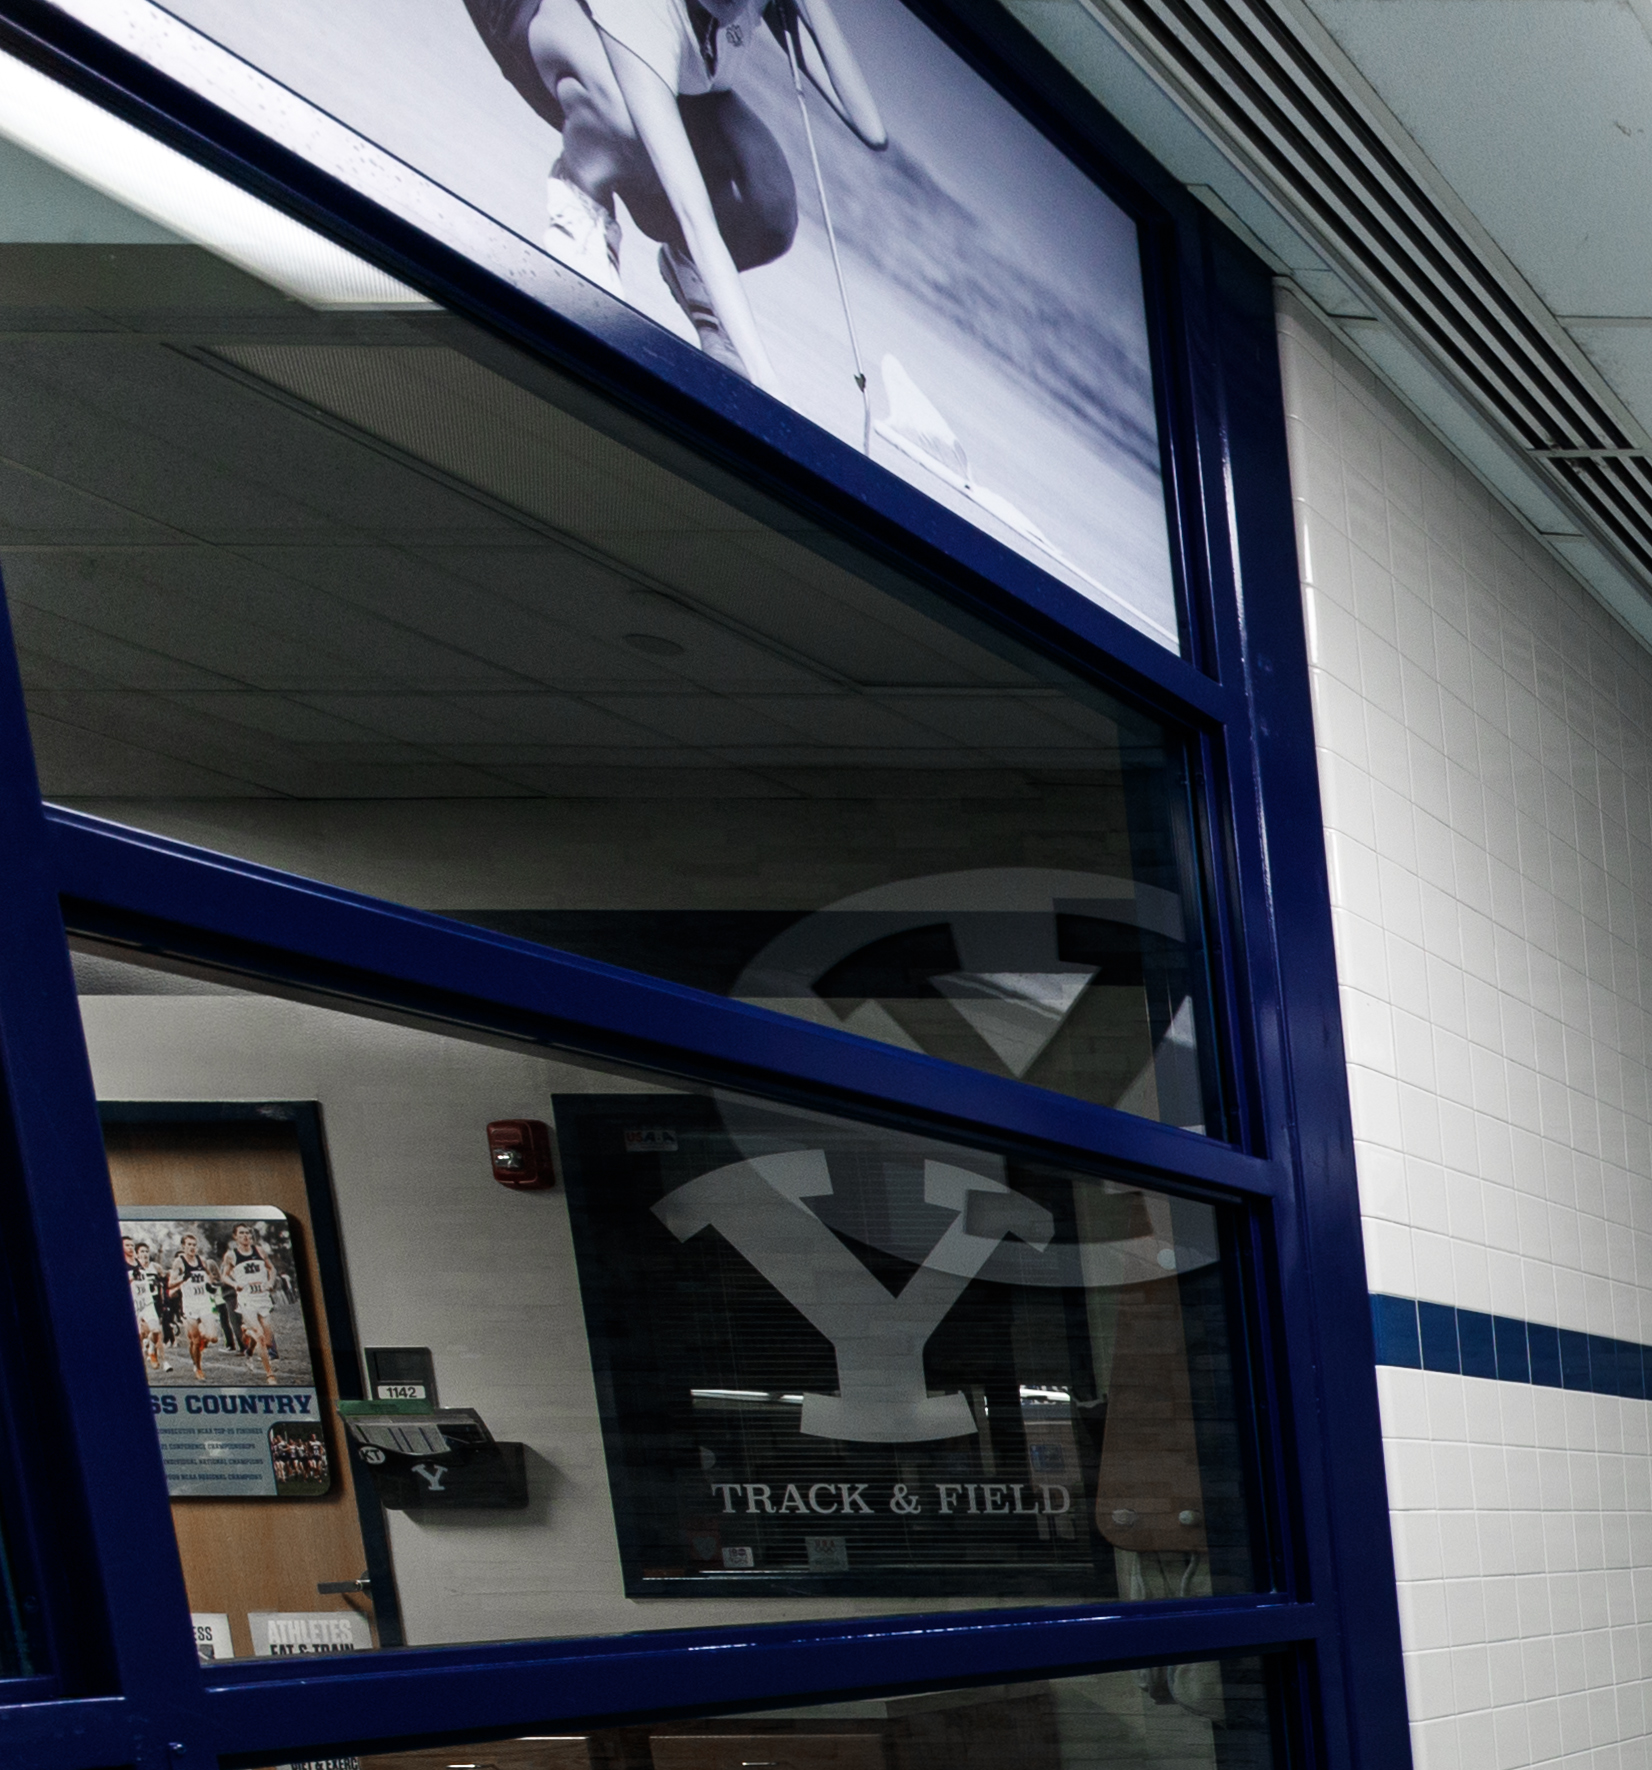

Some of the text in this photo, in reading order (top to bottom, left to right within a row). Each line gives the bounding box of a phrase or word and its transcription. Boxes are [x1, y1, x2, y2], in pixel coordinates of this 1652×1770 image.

[185, 1395, 312, 1414] COUNTRY
[386, 1386, 418, 1399] 1142
[411, 1463, 448, 1491] Y
[711, 1483, 1072, 1515] TRACK & FIELD
[267, 1619, 353, 1644] ATHLETES
